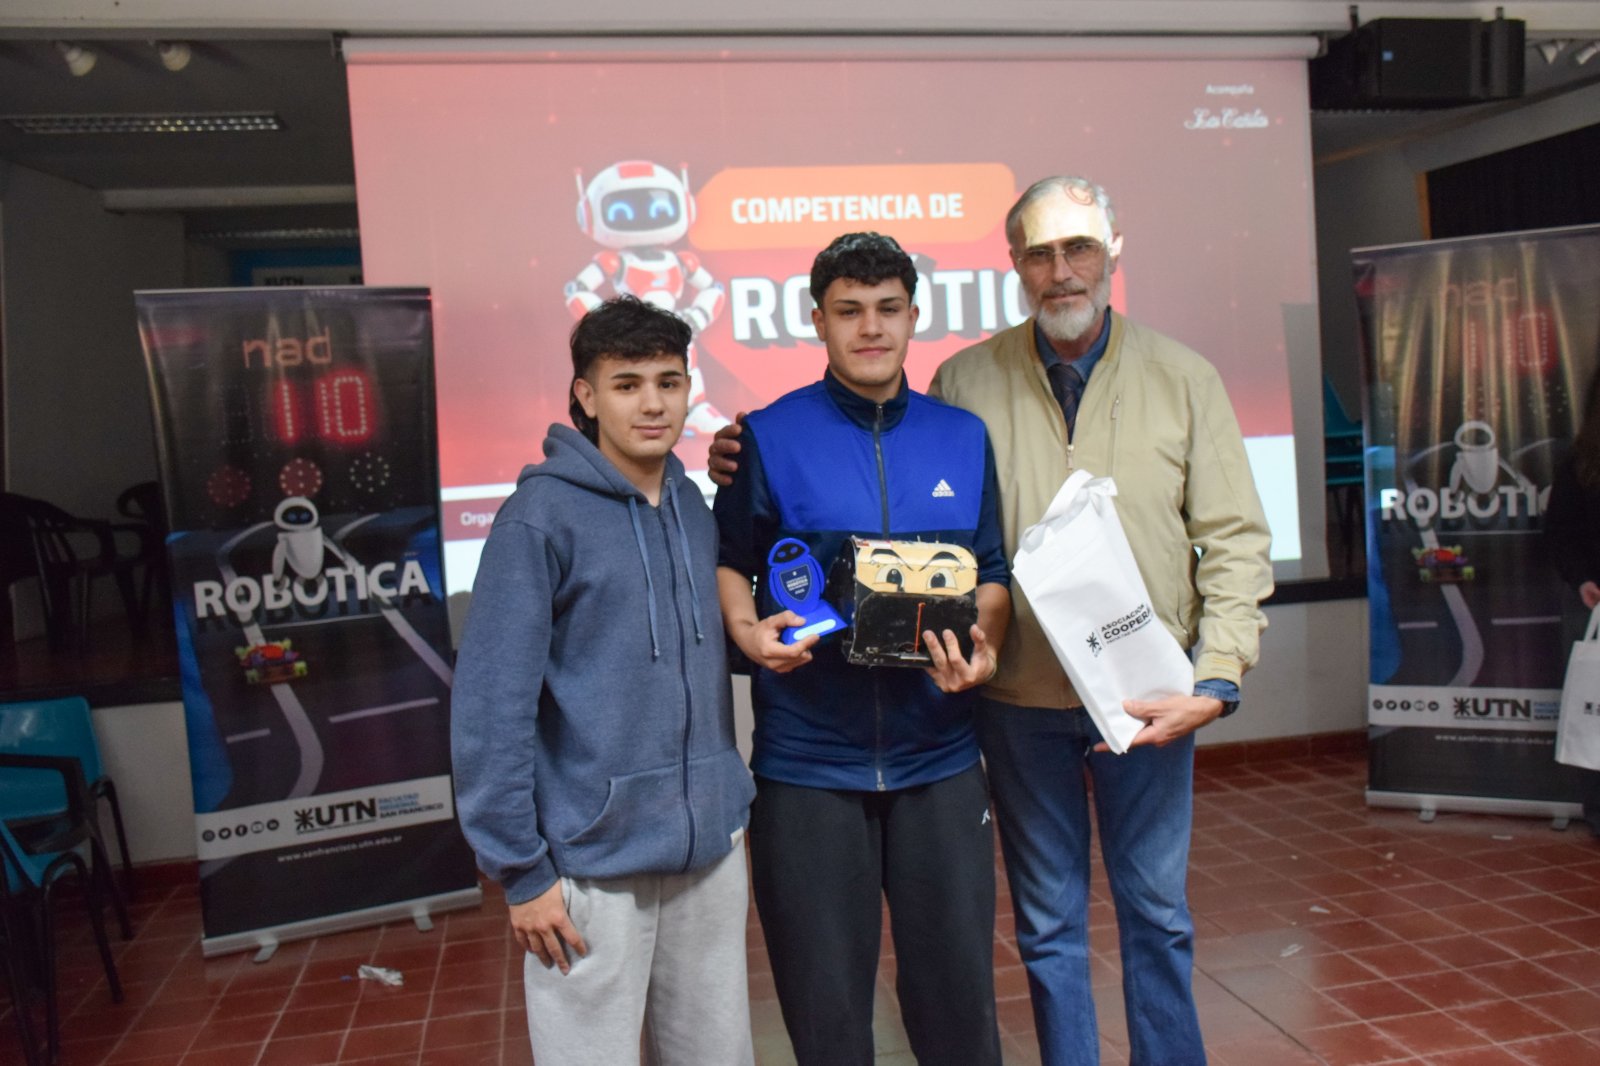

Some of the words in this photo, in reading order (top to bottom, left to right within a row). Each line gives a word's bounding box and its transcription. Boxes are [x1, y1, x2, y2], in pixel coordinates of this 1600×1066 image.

[731, 194, 923, 225] COMPETENCIA
[929, 193, 963, 219] DE
[194, 559, 430, 618] ROBOTICA
[1472, 698, 1531, 718] UTN
[315, 798, 376, 826] UTN
